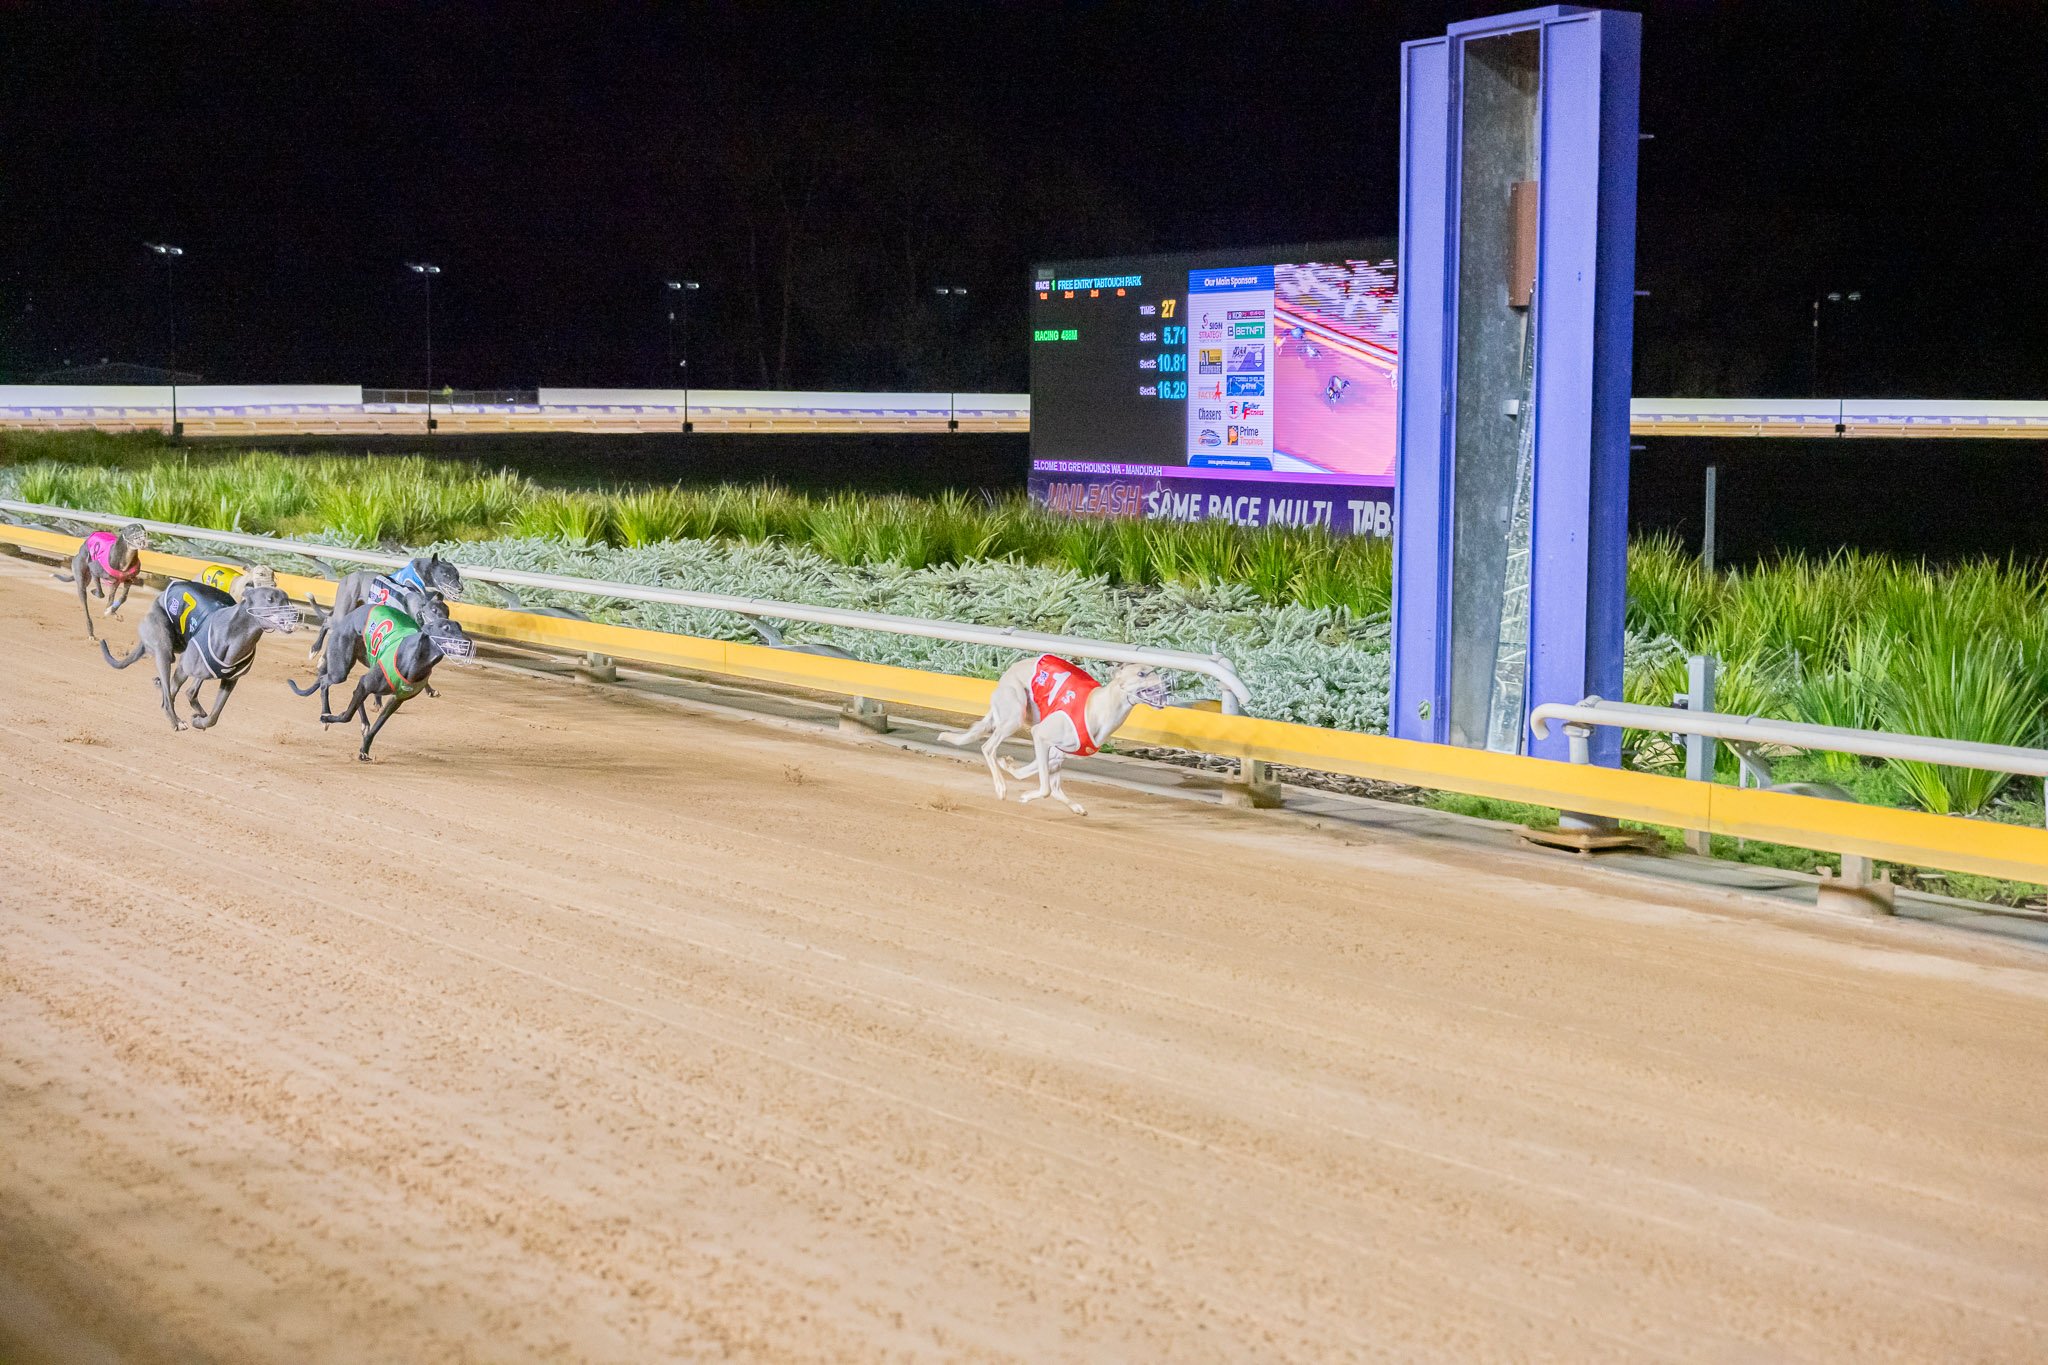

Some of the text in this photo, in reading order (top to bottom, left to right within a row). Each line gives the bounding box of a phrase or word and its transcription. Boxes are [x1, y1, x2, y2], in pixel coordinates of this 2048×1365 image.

[1035, 276, 1142, 292] RACE 1 FREE ENTRY TABTOUCH PARK
[1204, 276, 1258, 288] Our Main Sponsors
[1161, 299, 1176, 318] 27
[1034, 330, 1060, 341] RACING
[1163, 326, 1187, 345] 5.71
[1157, 353, 1187, 372] 10.81
[1157, 380, 1188, 399] 16.29
[1240, 426, 1259, 436] Prime
[1059, 461, 1067, 472] TO
[1068, 462, 1111, 473] GREYHOUNDS
[1111, 463, 1122, 473] WA
[1126, 464, 1163, 476] MANDURAH
[1048, 481, 1142, 516] UNLEASH
[1148, 490, 1333, 532] SAME RACE MULTI
[1347, 500, 1395, 538] TAB
[180, 592, 197, 635] 7
[371, 619, 394, 657] 6
[1047, 671, 1072, 707] 1
